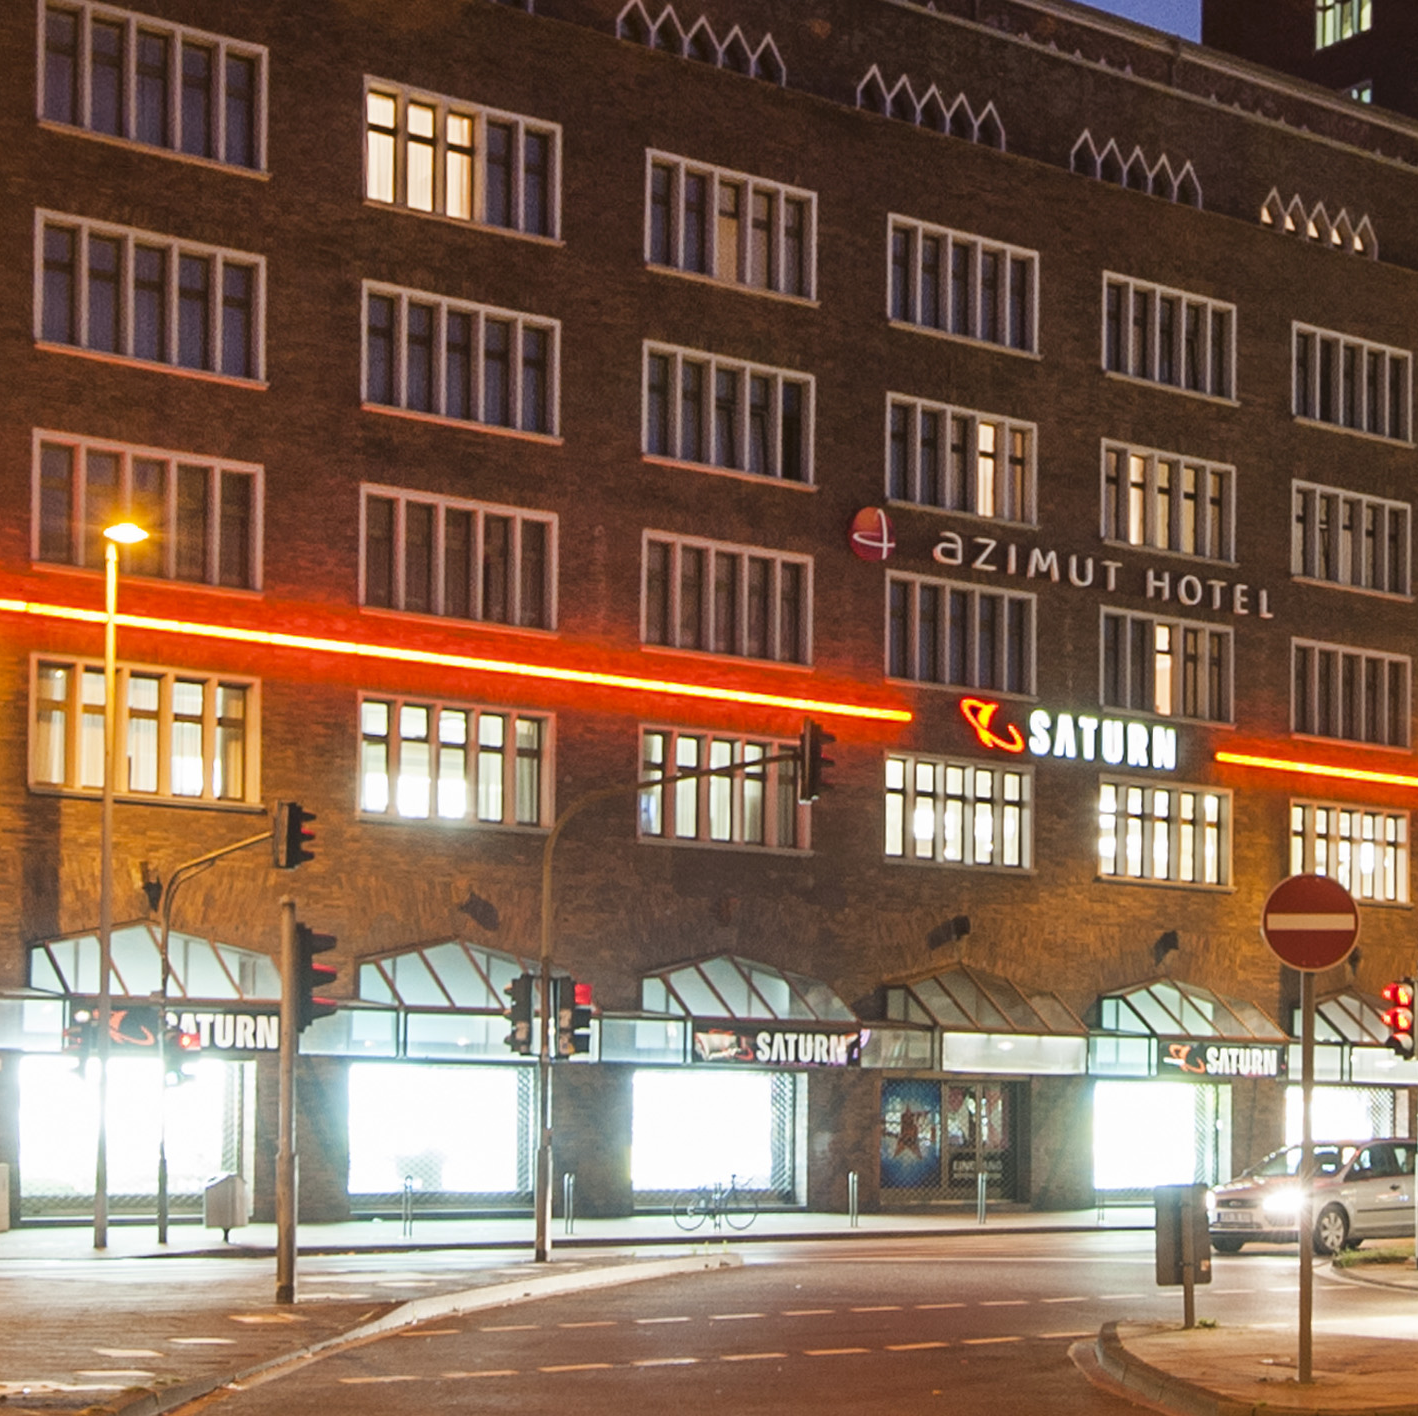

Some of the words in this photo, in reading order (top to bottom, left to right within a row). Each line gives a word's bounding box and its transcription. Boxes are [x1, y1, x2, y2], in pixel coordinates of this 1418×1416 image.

[1145, 567, 1275, 619] HOTEL
[1027, 707, 1178, 771] SATURN
[755, 1030, 848, 1066] SATURN
[1205, 1046, 1278, 1077] SATURN
